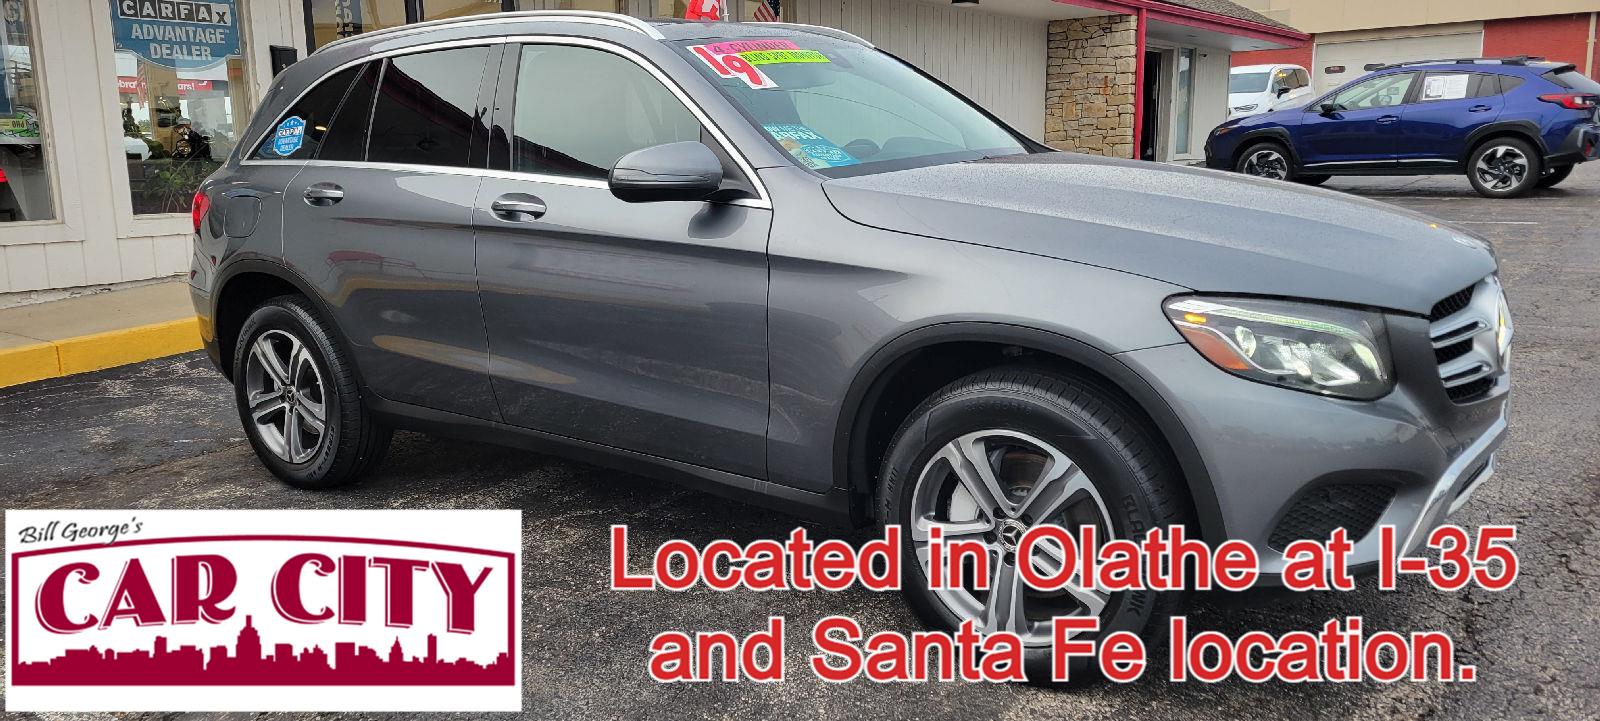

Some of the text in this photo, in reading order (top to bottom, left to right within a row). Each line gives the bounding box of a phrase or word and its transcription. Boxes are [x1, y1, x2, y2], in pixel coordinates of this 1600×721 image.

[122, 0, 227, 24] CARFAX
[131, 24, 226, 44] ADVANTAGE
[150, 43, 212, 60] DEALER
[740, 53, 770, 63] BLIND
[693, 47, 763, 86] 19
[278, 126, 303, 136] CARFAX
